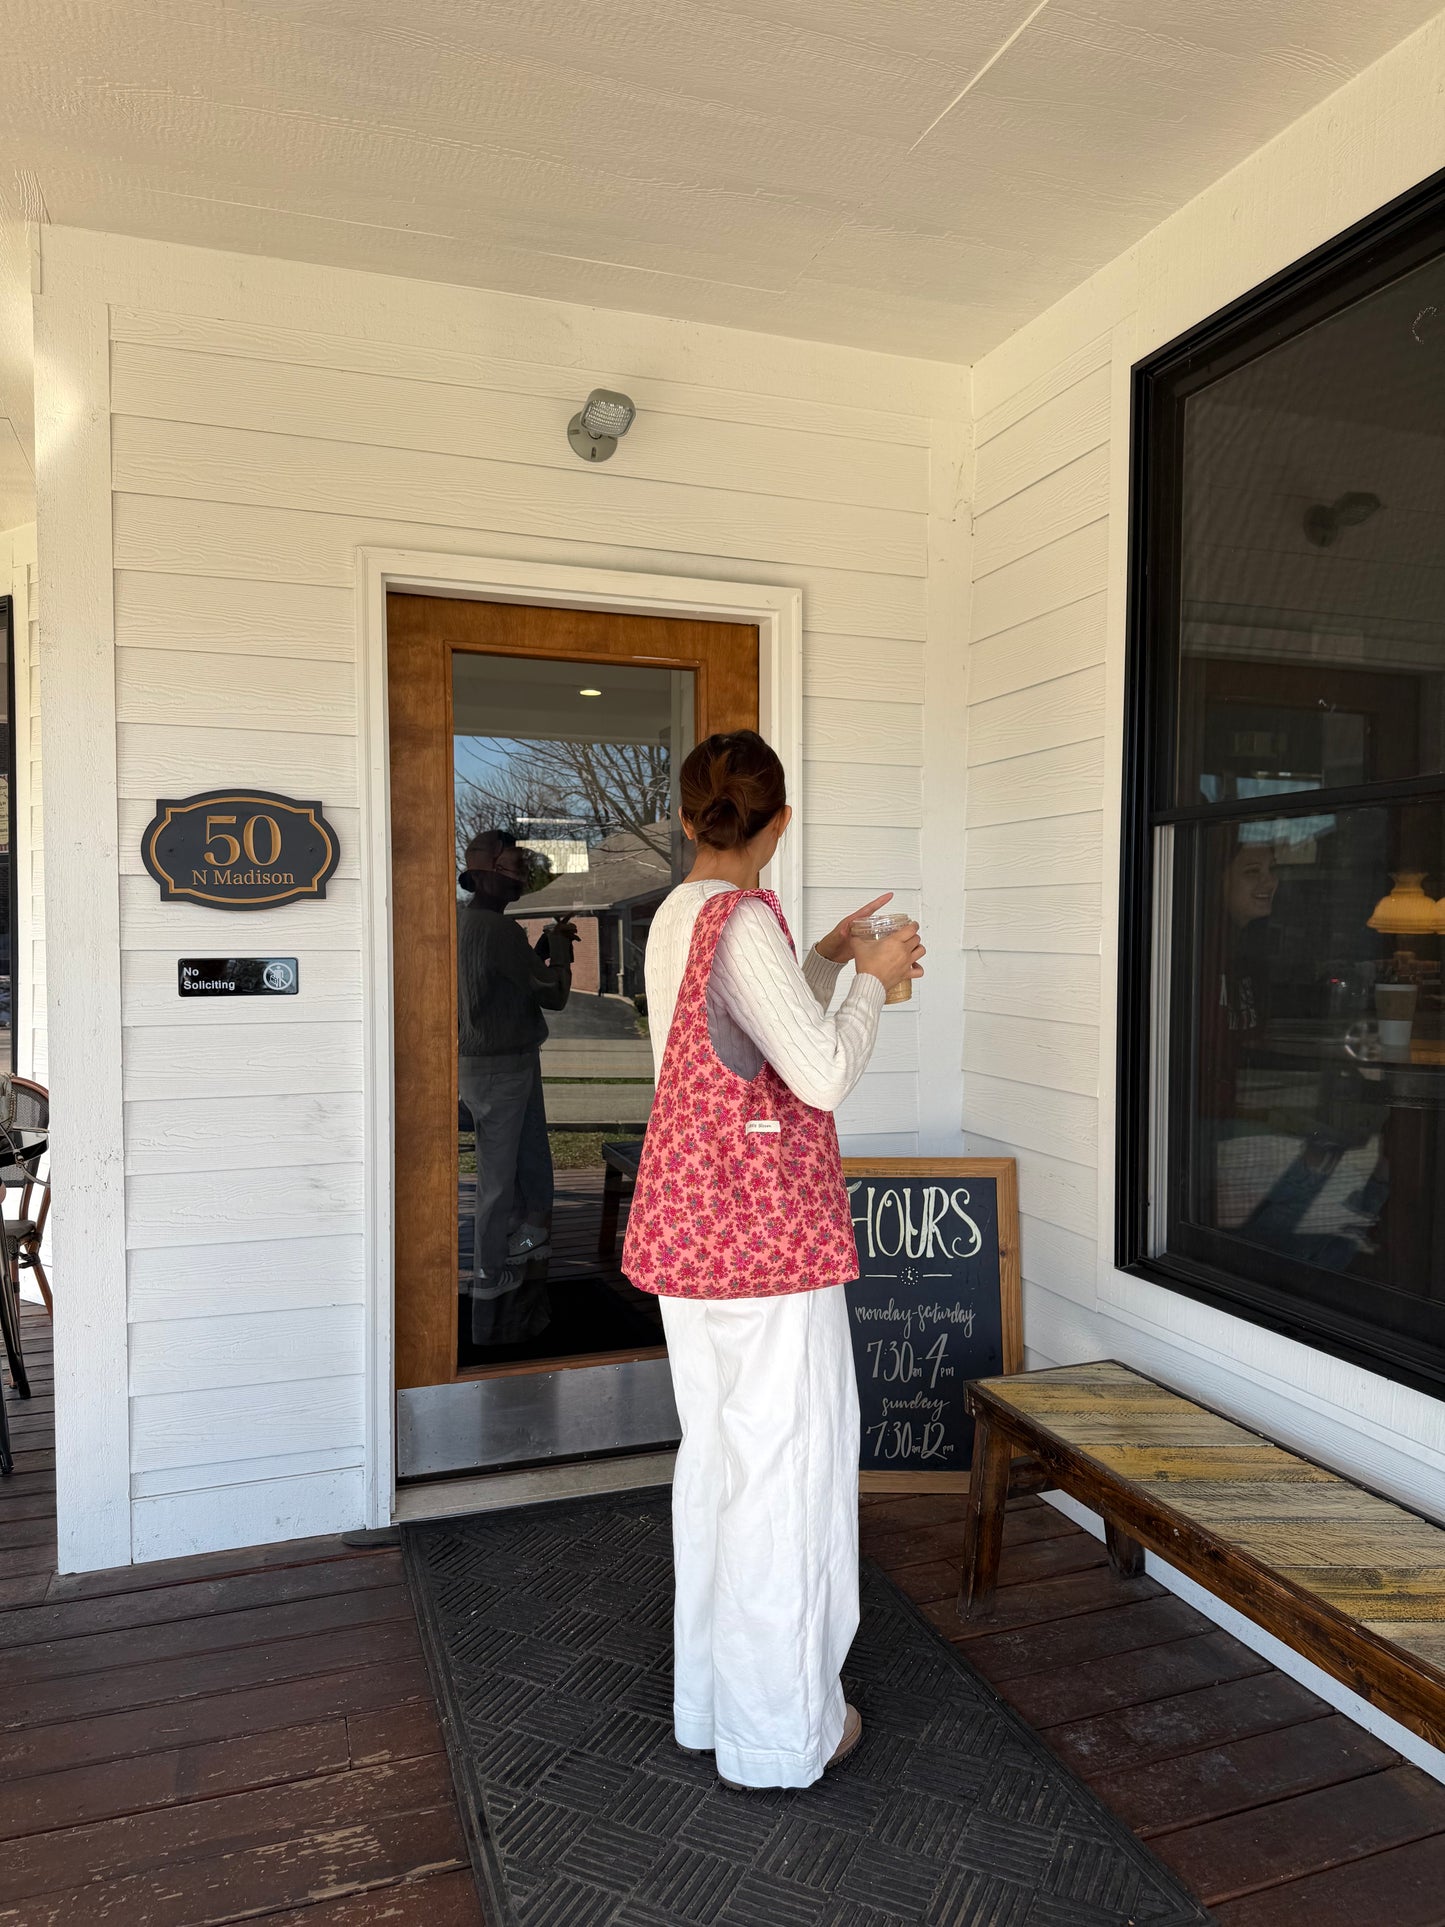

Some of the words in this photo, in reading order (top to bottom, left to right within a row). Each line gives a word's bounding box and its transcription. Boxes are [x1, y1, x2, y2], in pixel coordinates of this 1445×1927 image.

[203, 814, 282, 867] 50
[191, 869, 208, 886] N
[213, 869, 295, 886] Madison
[183, 966, 199, 977] No
[183, 979, 236, 991] Soliciting
[882, 1391, 950, 1422] sunday
